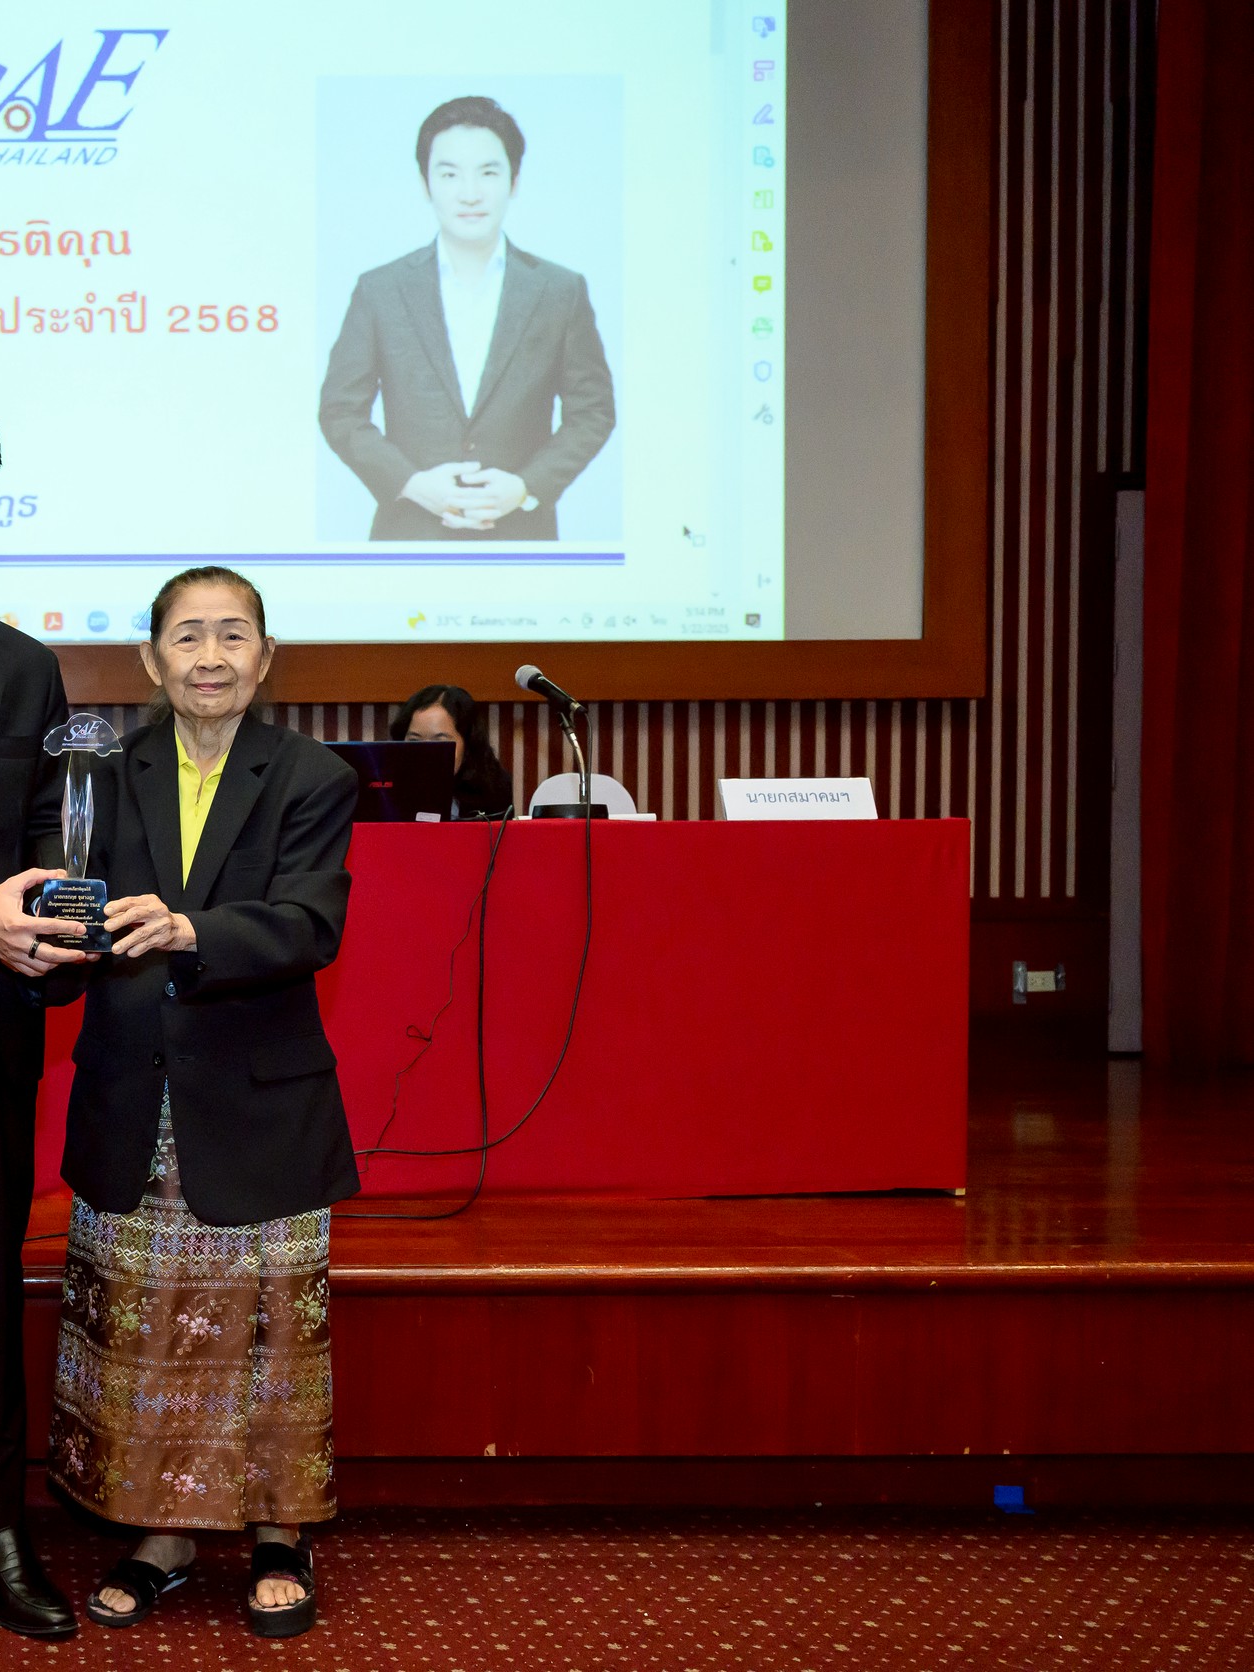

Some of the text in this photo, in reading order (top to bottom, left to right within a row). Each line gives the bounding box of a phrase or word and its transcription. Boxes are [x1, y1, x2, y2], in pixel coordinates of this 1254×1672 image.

[167, 305, 280, 333] 2568
[63, 720, 103, 742] SAE
[745, 791, 851, 804] นายกสมาคมฯ
